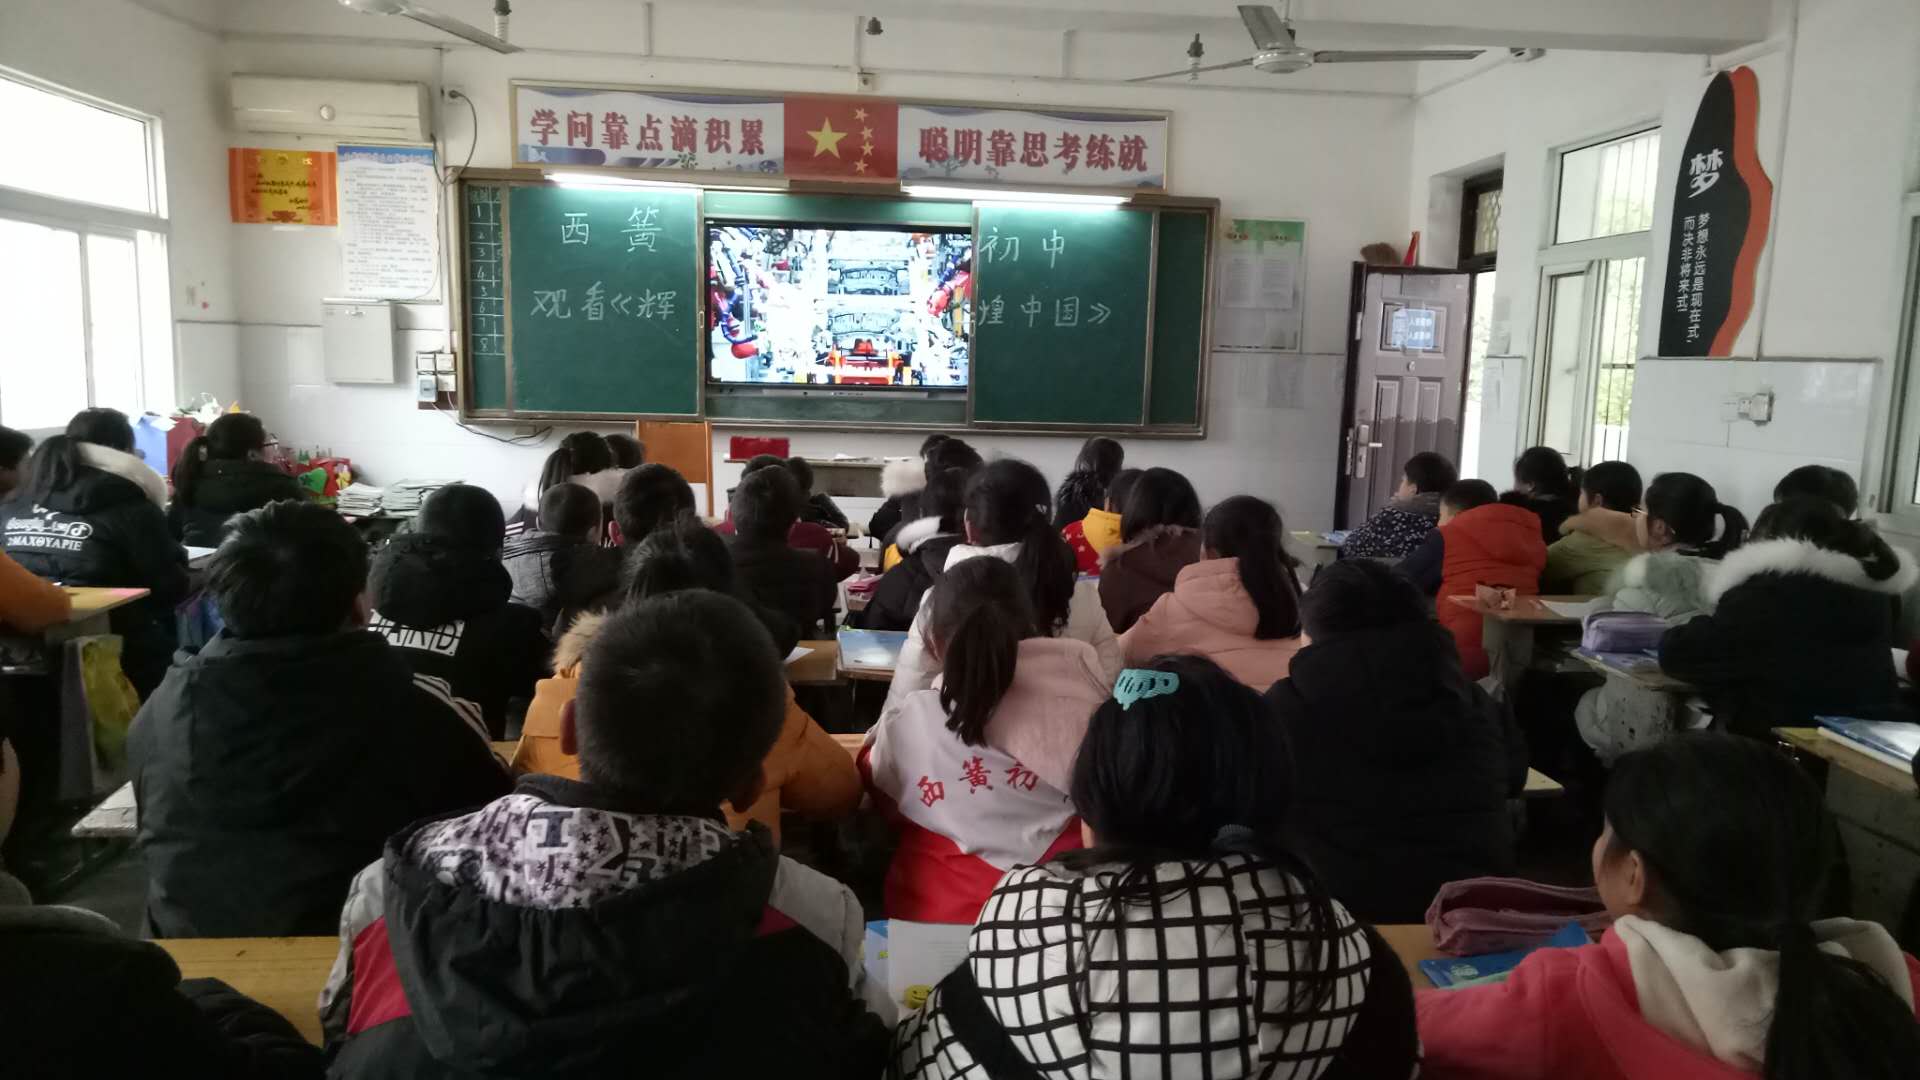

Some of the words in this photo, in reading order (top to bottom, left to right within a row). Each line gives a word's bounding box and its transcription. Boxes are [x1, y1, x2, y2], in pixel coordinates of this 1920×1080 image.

[530, 108, 765, 156] 学问靠点滴积累
[918, 126, 1149, 173] 聪明靠思考练就
[1688, 147, 1725, 199] 梦
[561, 205, 663, 253] 西簧
[979, 226, 1065, 269] 初中
[530, 281, 677, 321] 观看《辉
[978, 295, 1112, 328] 煌中国》
